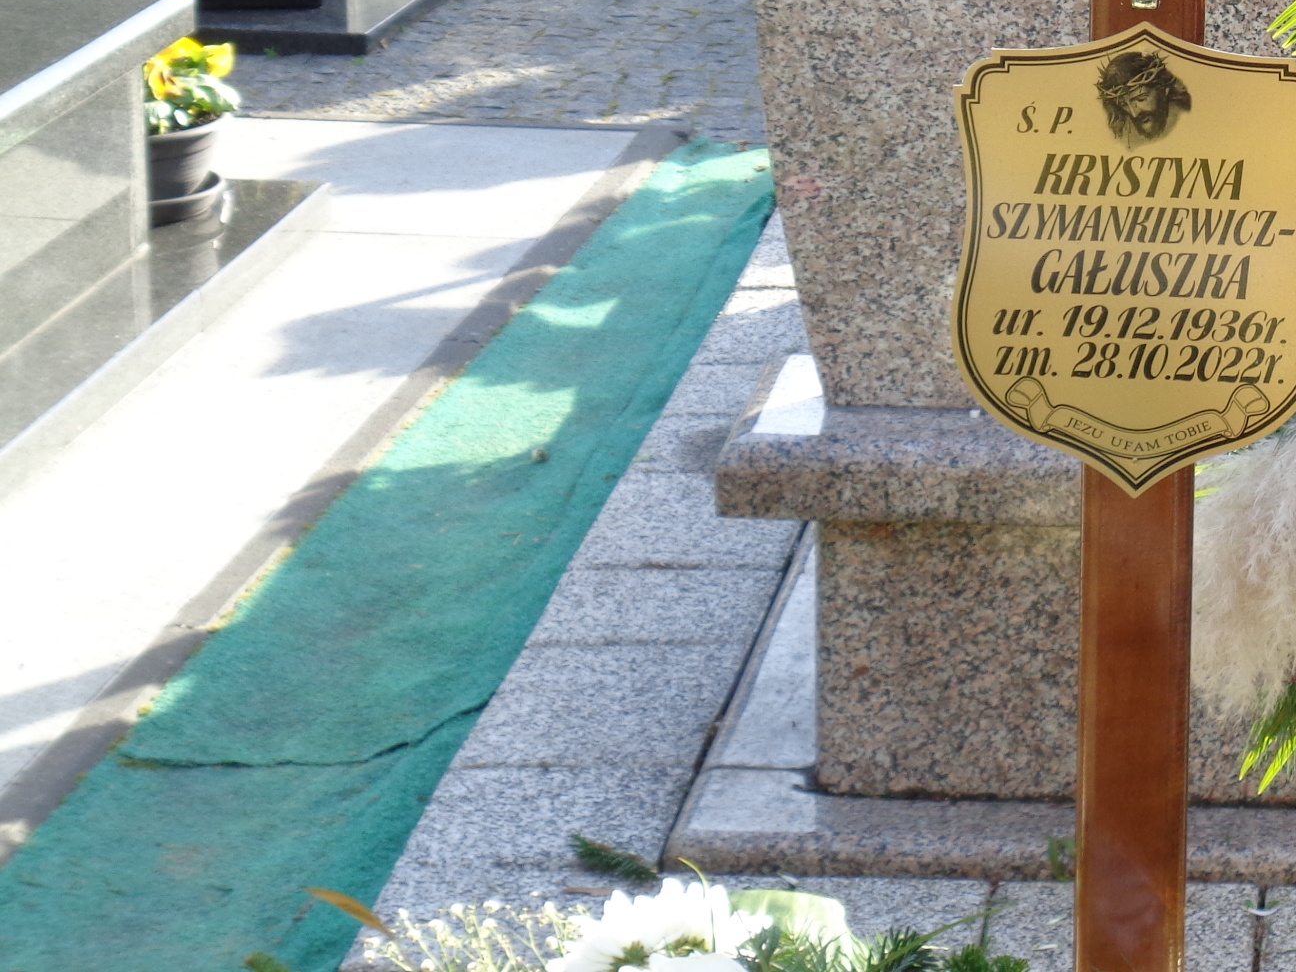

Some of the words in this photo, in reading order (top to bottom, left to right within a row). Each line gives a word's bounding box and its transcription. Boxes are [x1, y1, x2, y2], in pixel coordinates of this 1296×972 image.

[1034, 153, 1244, 201] KRYSTYNA
[986, 202, 1296, 247] SZYMANKIEWICZ-
[1030, 248, 1251, 300] GAŁUSZKA
[992, 308, 1043, 336] ur.
[1062, 304, 1287, 344] 19.12.1936r.
[994, 345, 1058, 377] zm.
[1070, 342, 1285, 385] 28.10.2022r.
[1064, 417, 1104, 439] JEZU
[1110, 436, 1160, 452] UFAM
[1164, 420, 1212, 445] TOBIE
